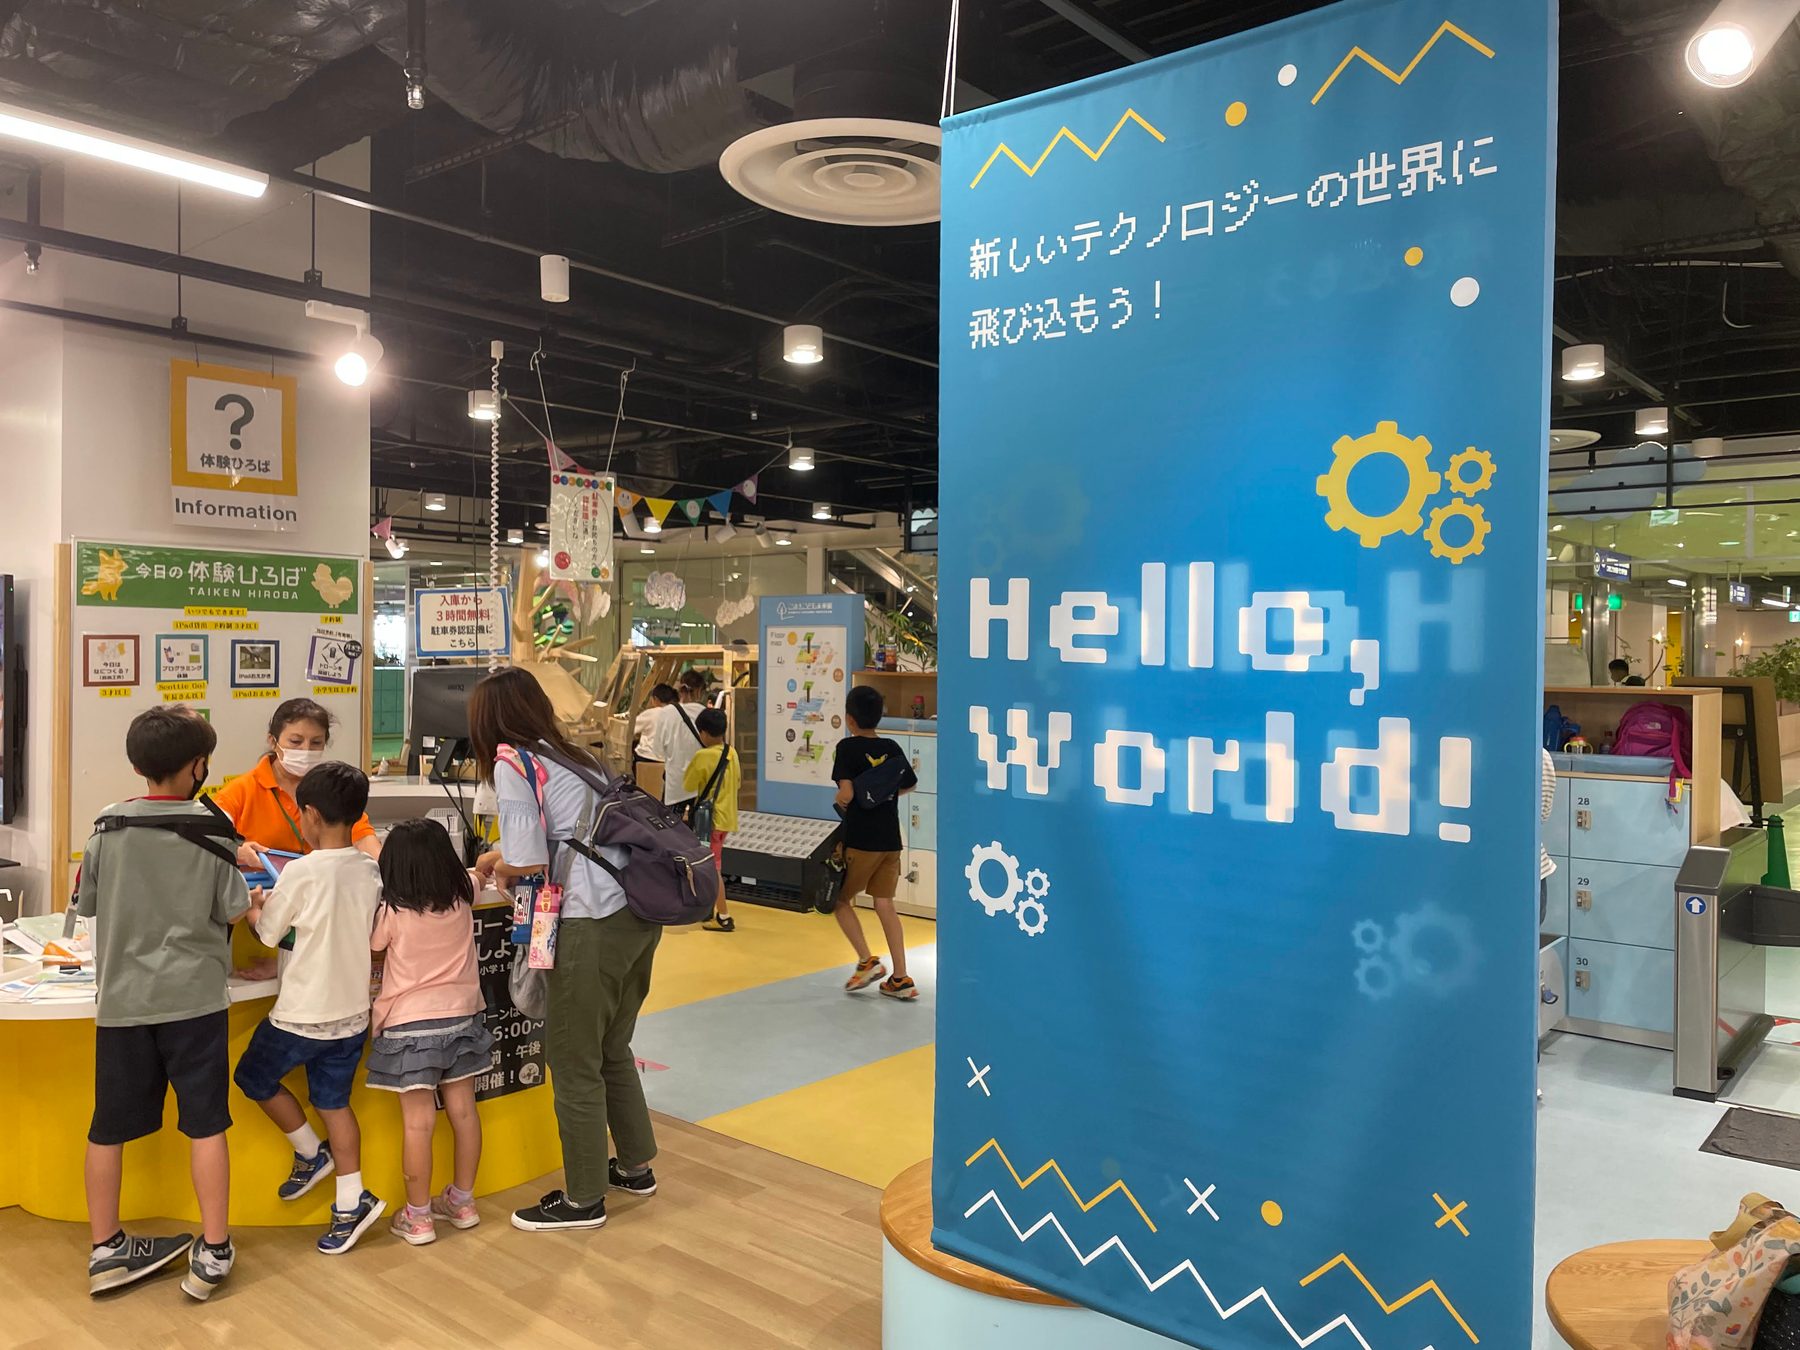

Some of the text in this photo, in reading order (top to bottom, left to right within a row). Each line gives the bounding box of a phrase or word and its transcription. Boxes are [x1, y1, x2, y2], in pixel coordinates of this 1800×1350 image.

[969, 136, 1498, 280] 新しいテクノロジーの世界に
[200, 453, 271, 473] 体験ひろば
[175, 498, 298, 522] Information
[188, 586, 299, 600] TAIKEN HIROBA
[440, 594, 483, 607] 入庫から
[969, 561, 1380, 705] Hello,
[450, 639, 476, 648] こちら
[969, 705, 1472, 843] World!
[1577, 797, 1590, 806] 28
[1577, 877, 1590, 886] 29
[1576, 957, 1589, 966] 30
